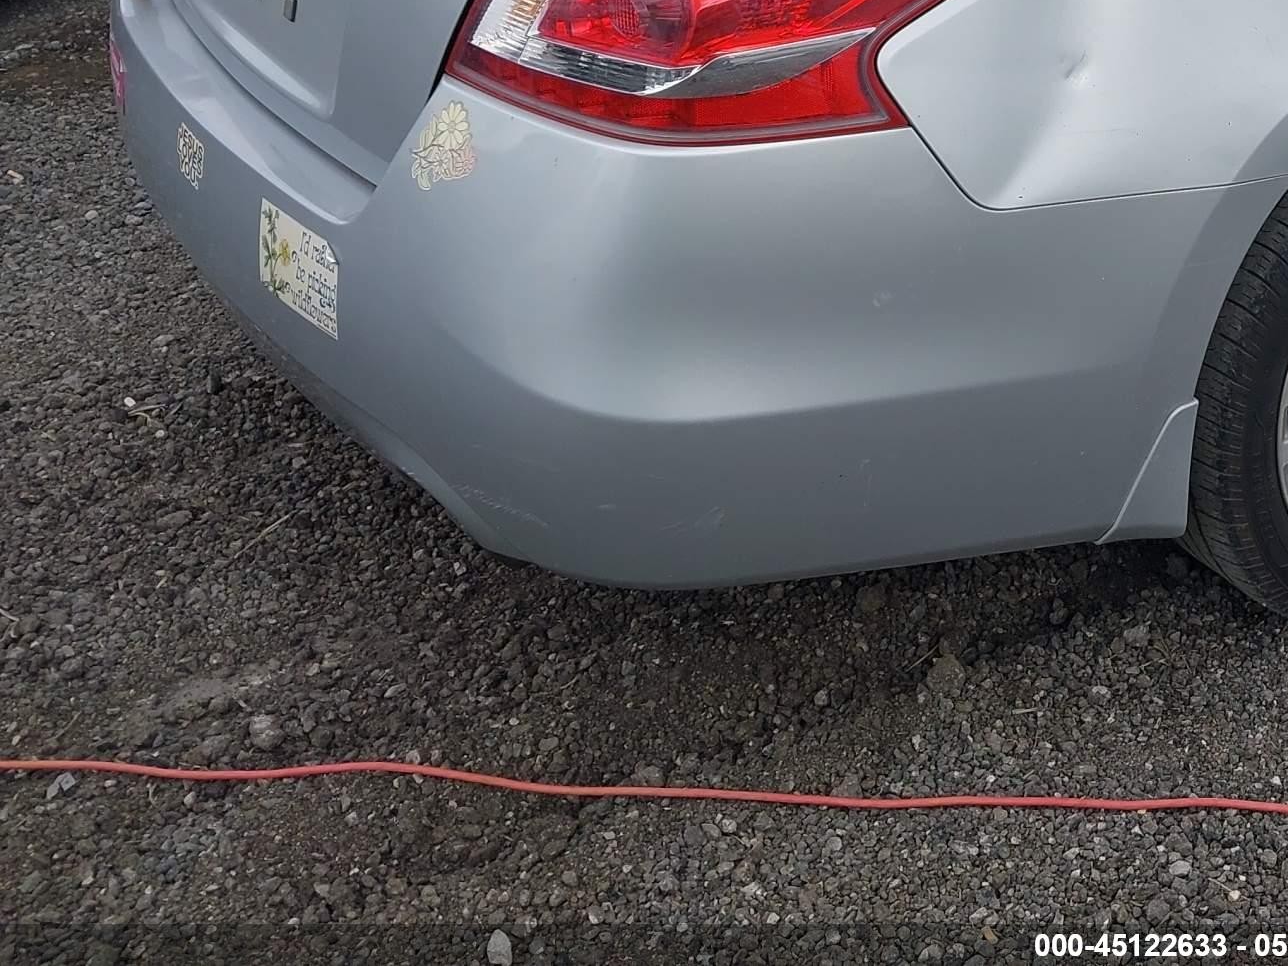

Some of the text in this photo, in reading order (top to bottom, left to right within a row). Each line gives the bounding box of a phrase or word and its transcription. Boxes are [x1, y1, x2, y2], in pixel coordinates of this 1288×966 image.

[177, 138, 202, 176] LOVES
[178, 126, 203, 161] JESUS
[296, 258, 337, 313] be picking
[289, 288, 337, 333] wildflowers
